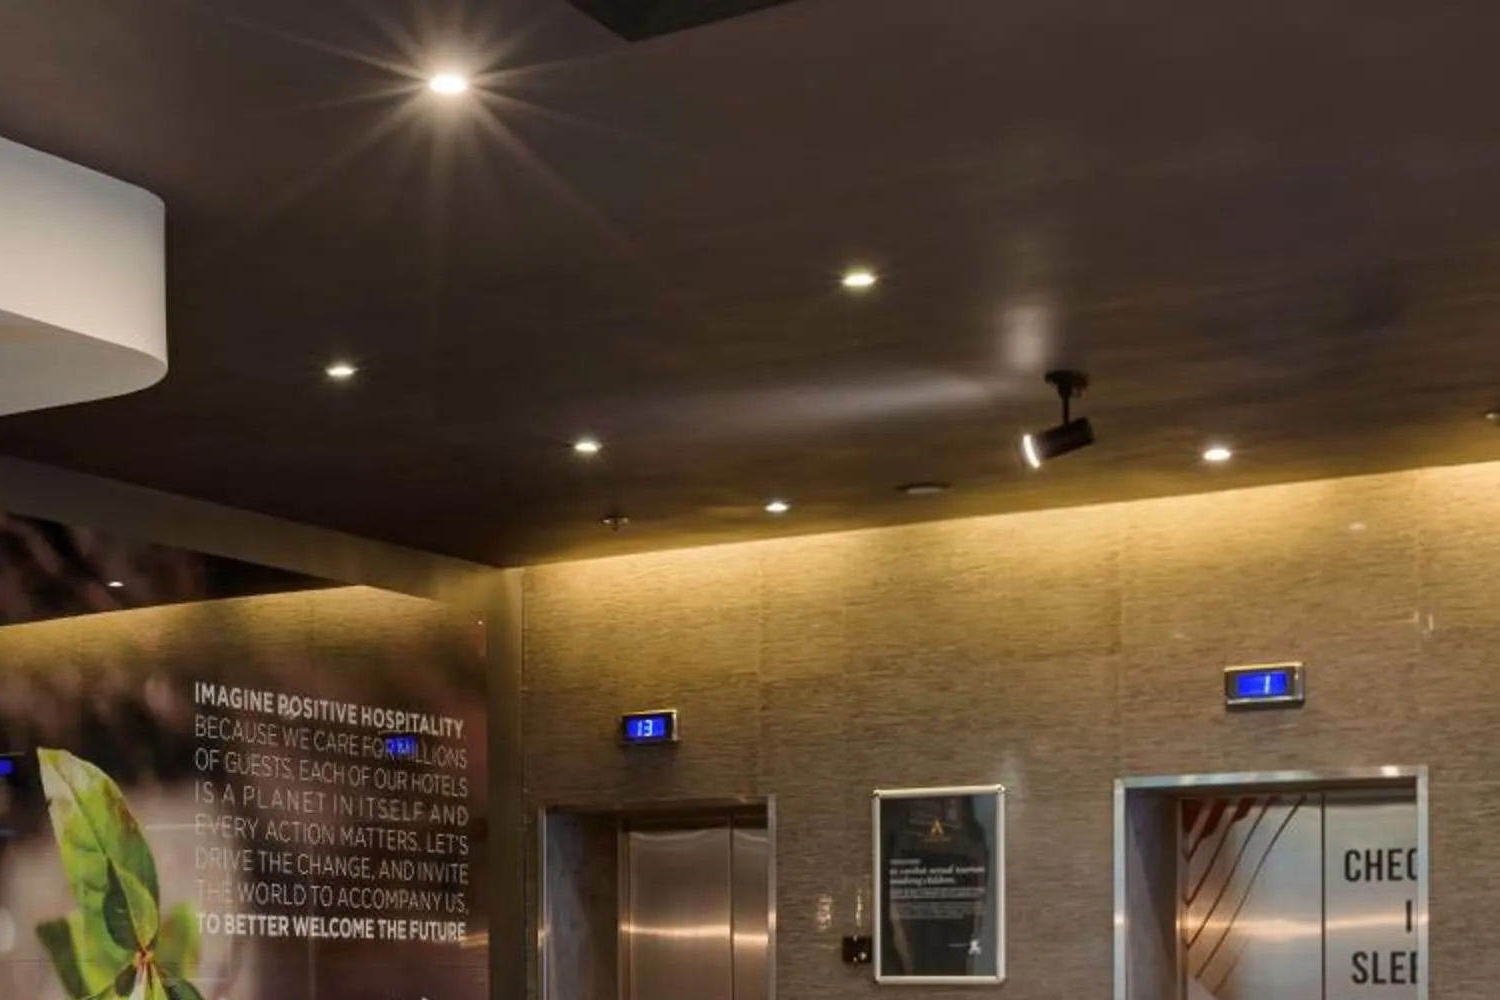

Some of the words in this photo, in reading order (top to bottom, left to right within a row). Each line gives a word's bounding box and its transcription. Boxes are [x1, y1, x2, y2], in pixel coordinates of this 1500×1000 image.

[195, 682, 274, 713] IMAGINE
[277, 694, 357, 725] POSITIVE
[195, 714, 276, 746] BECAUSE
[283, 727, 308, 751] WE
[314, 730, 360, 755] CARE
[636, 718, 654, 738] 13
[195, 748, 218, 773] OF
[298, 759, 345, 786] EACH
[348, 765, 370, 788] OF
[374, 767, 407, 792] OUR
[411, 773, 469, 798] HOTELS
[195, 781, 213, 805] IS
[221, 784, 235, 805] A
[243, 785, 325, 814] PLANET
[333, 795, 355, 818] IN
[359, 797, 423, 822] ITSELF
[430, 804, 469, 827] AND
[195, 814, 259, 840] EVERY
[265, 820, 335, 846] ACTION
[427, 832, 469, 856] LET'S
[195, 846, 253, 872] DRIVE
[259, 851, 293, 874] THE
[379, 860, 414, 883] AND
[418, 862, 469, 884] INVITE
[197, 879, 232, 903] THE
[238, 882, 306, 907] WORLD
[312, 886, 333, 907] TO
[338, 887, 440, 912] ACCOMPANY
[196, 912, 221, 934] TO
[225, 913, 289, 936] BETTER
[293, 917, 374, 939] WELCOME
[377, 919, 406, 940] THE
[409, 920, 466, 942] FUTURE
